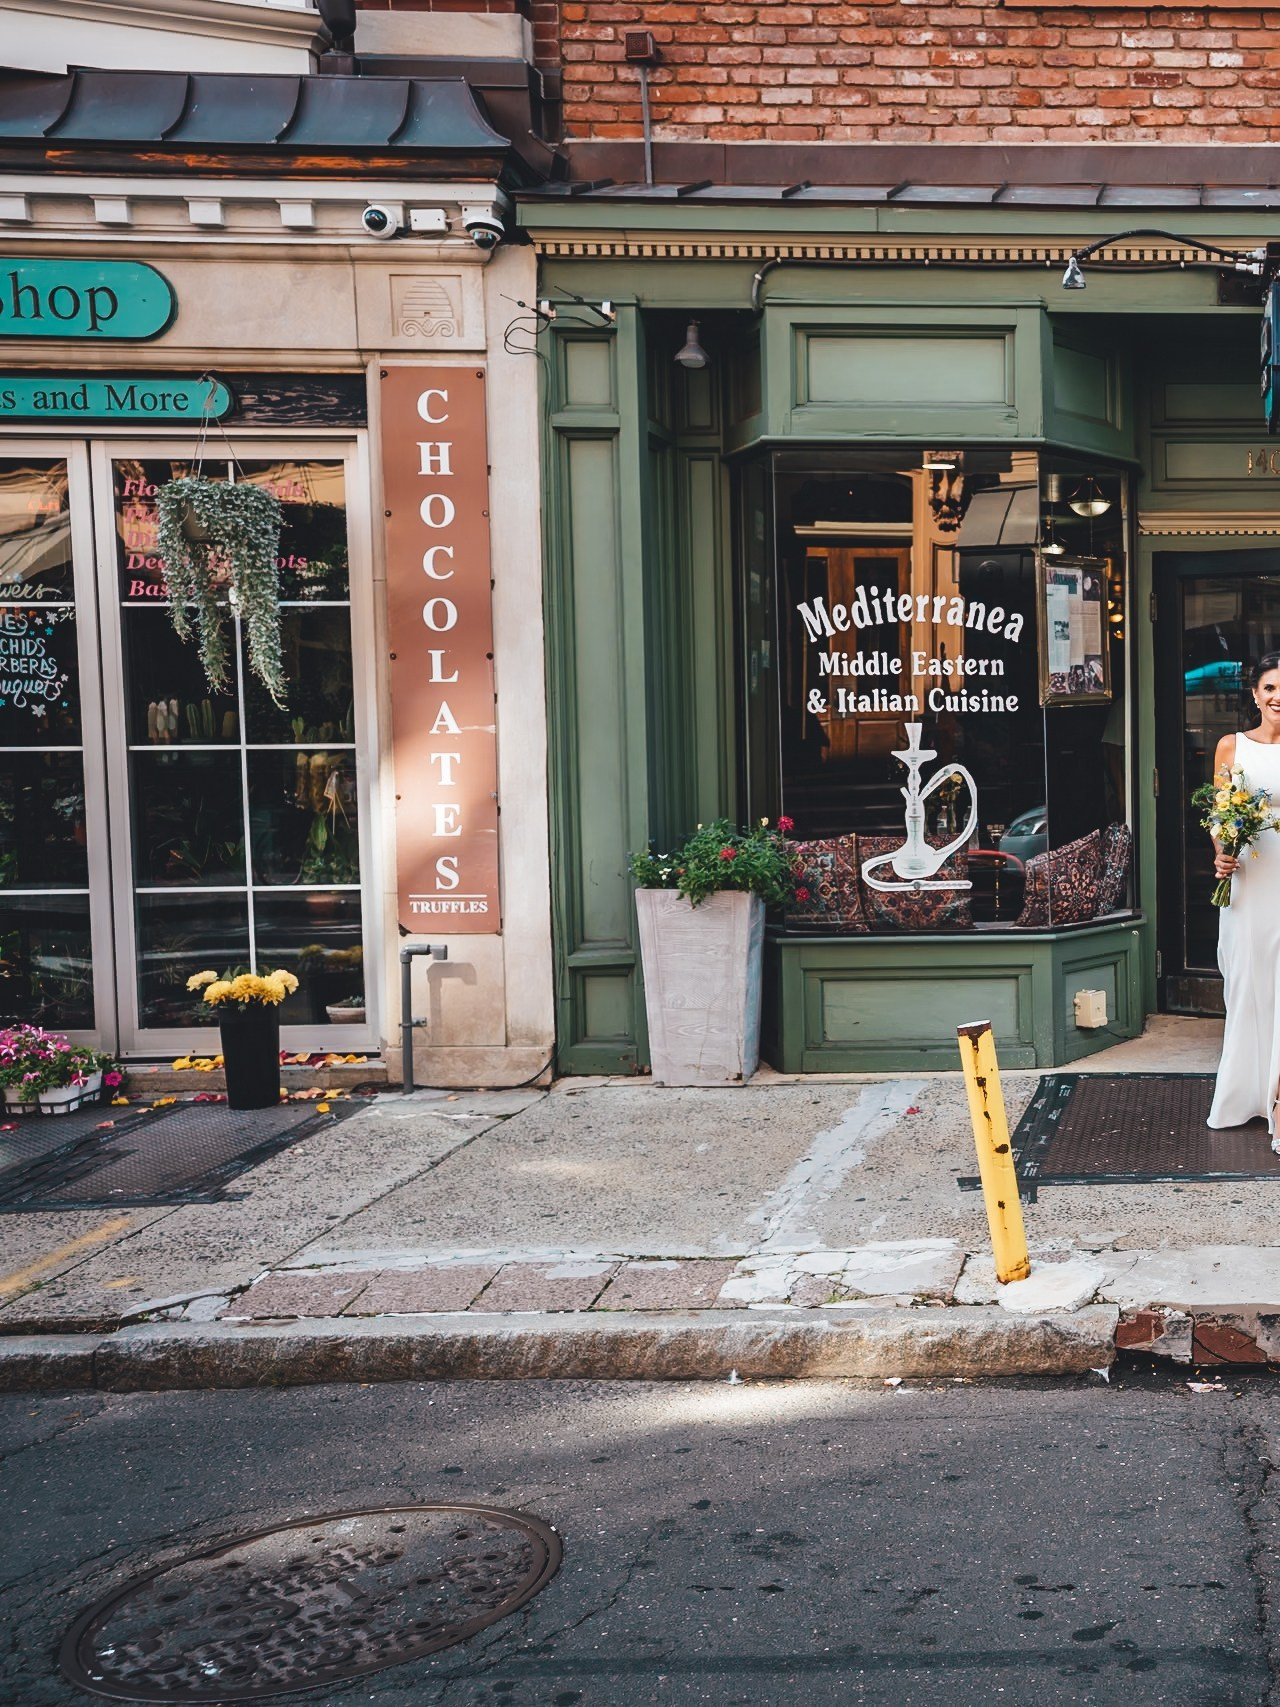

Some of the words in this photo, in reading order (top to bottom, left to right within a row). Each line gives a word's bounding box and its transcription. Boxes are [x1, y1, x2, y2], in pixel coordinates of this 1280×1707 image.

[0, 271, 118, 332] hop
[33, 384, 90, 411] and
[104, 385, 189, 411] More
[797, 585, 1024, 643] Mediterranea
[416, 389, 462, 890] CHOCOLATES
[819, 651, 902, 677] Middle
[912, 652, 1004, 676] Eastern
[806, 689, 827, 714] &
[837, 688, 919, 712] Italian
[928, 688, 1019, 712] Cuisine
[409, 901, 488, 913] TRUFFLES
